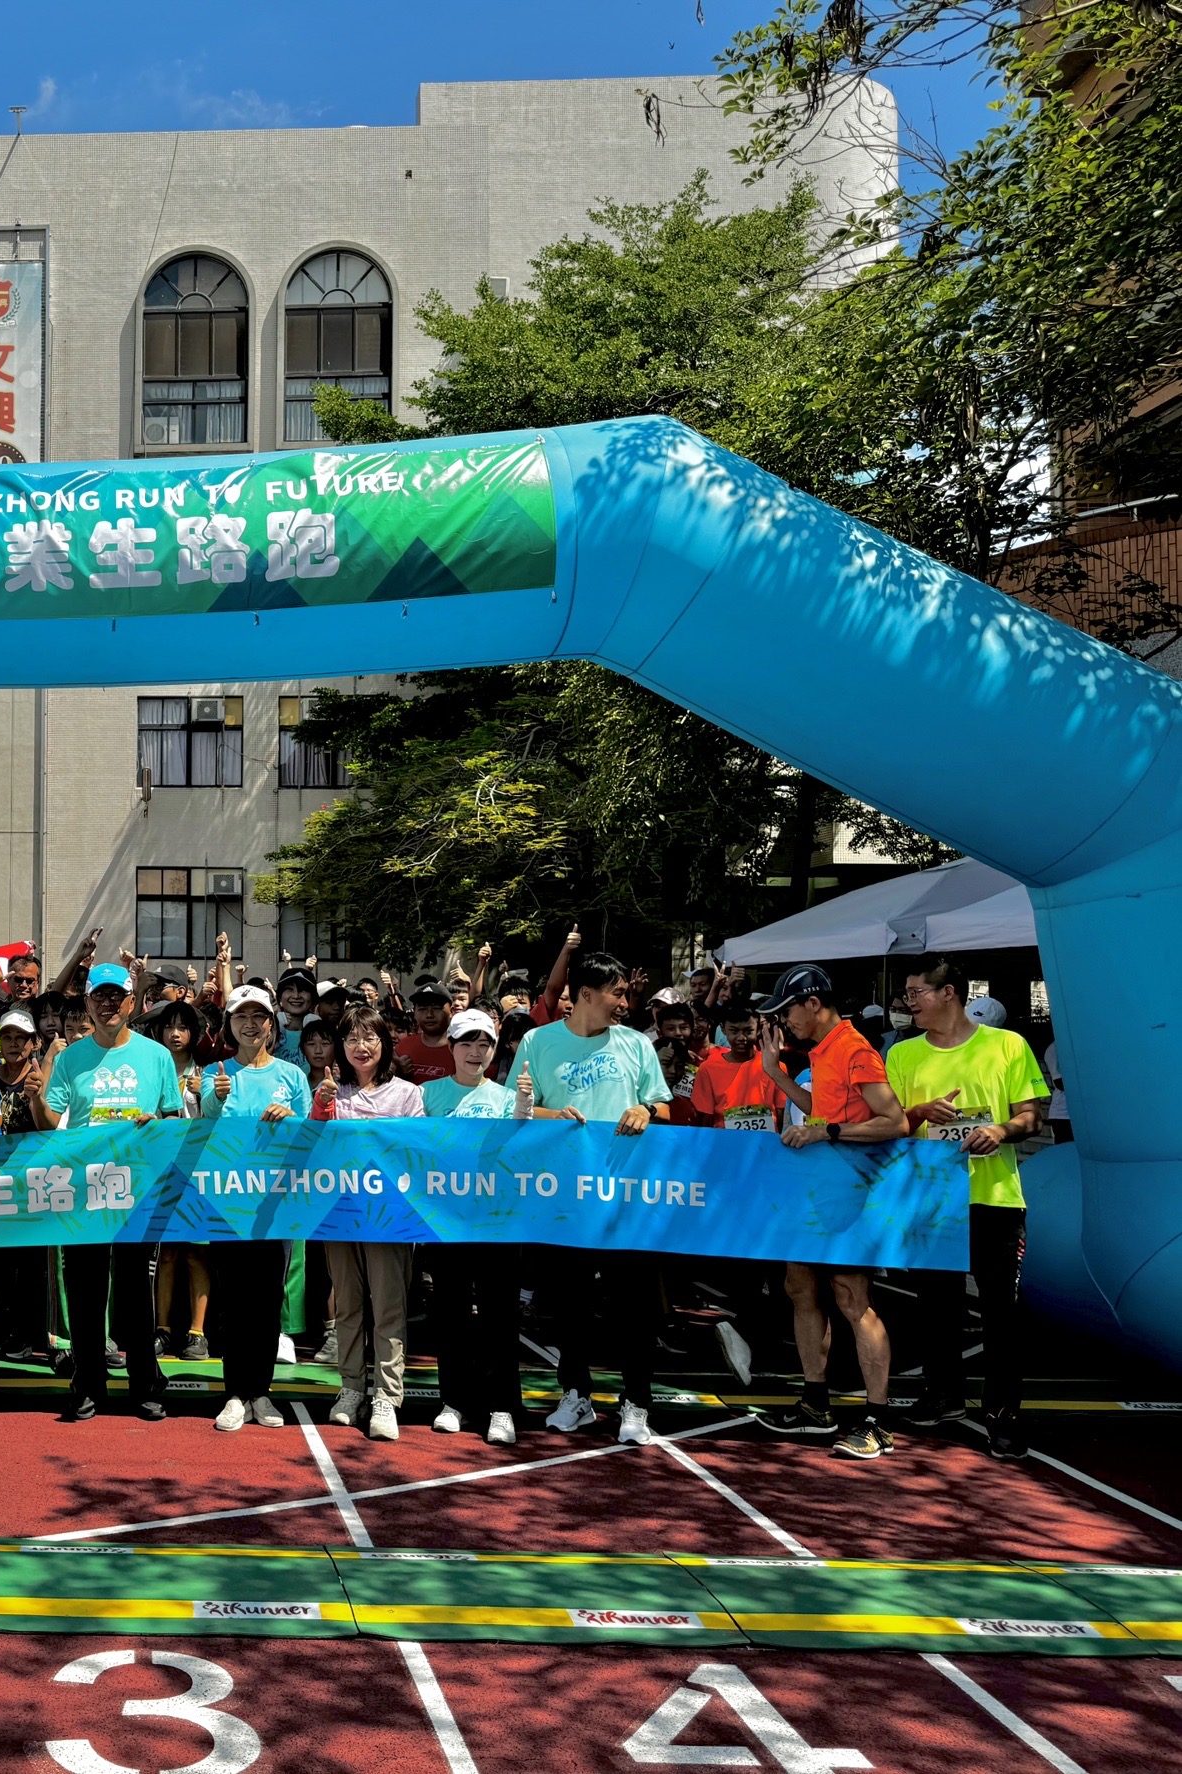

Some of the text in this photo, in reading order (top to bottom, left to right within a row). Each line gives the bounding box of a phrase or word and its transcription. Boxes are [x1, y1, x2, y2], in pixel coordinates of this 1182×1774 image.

[115, 487, 185, 509] RUN
[266, 471, 404, 502] FUTURE
[734, 1119, 767, 1131] 2352
[939, 1126, 979, 1141] 236
[192, 1168, 706, 1208] TIANZHONG RUN TO FUTURE
[45, 1649, 262, 1774] 3
[622, 1663, 875, 1774] 4
